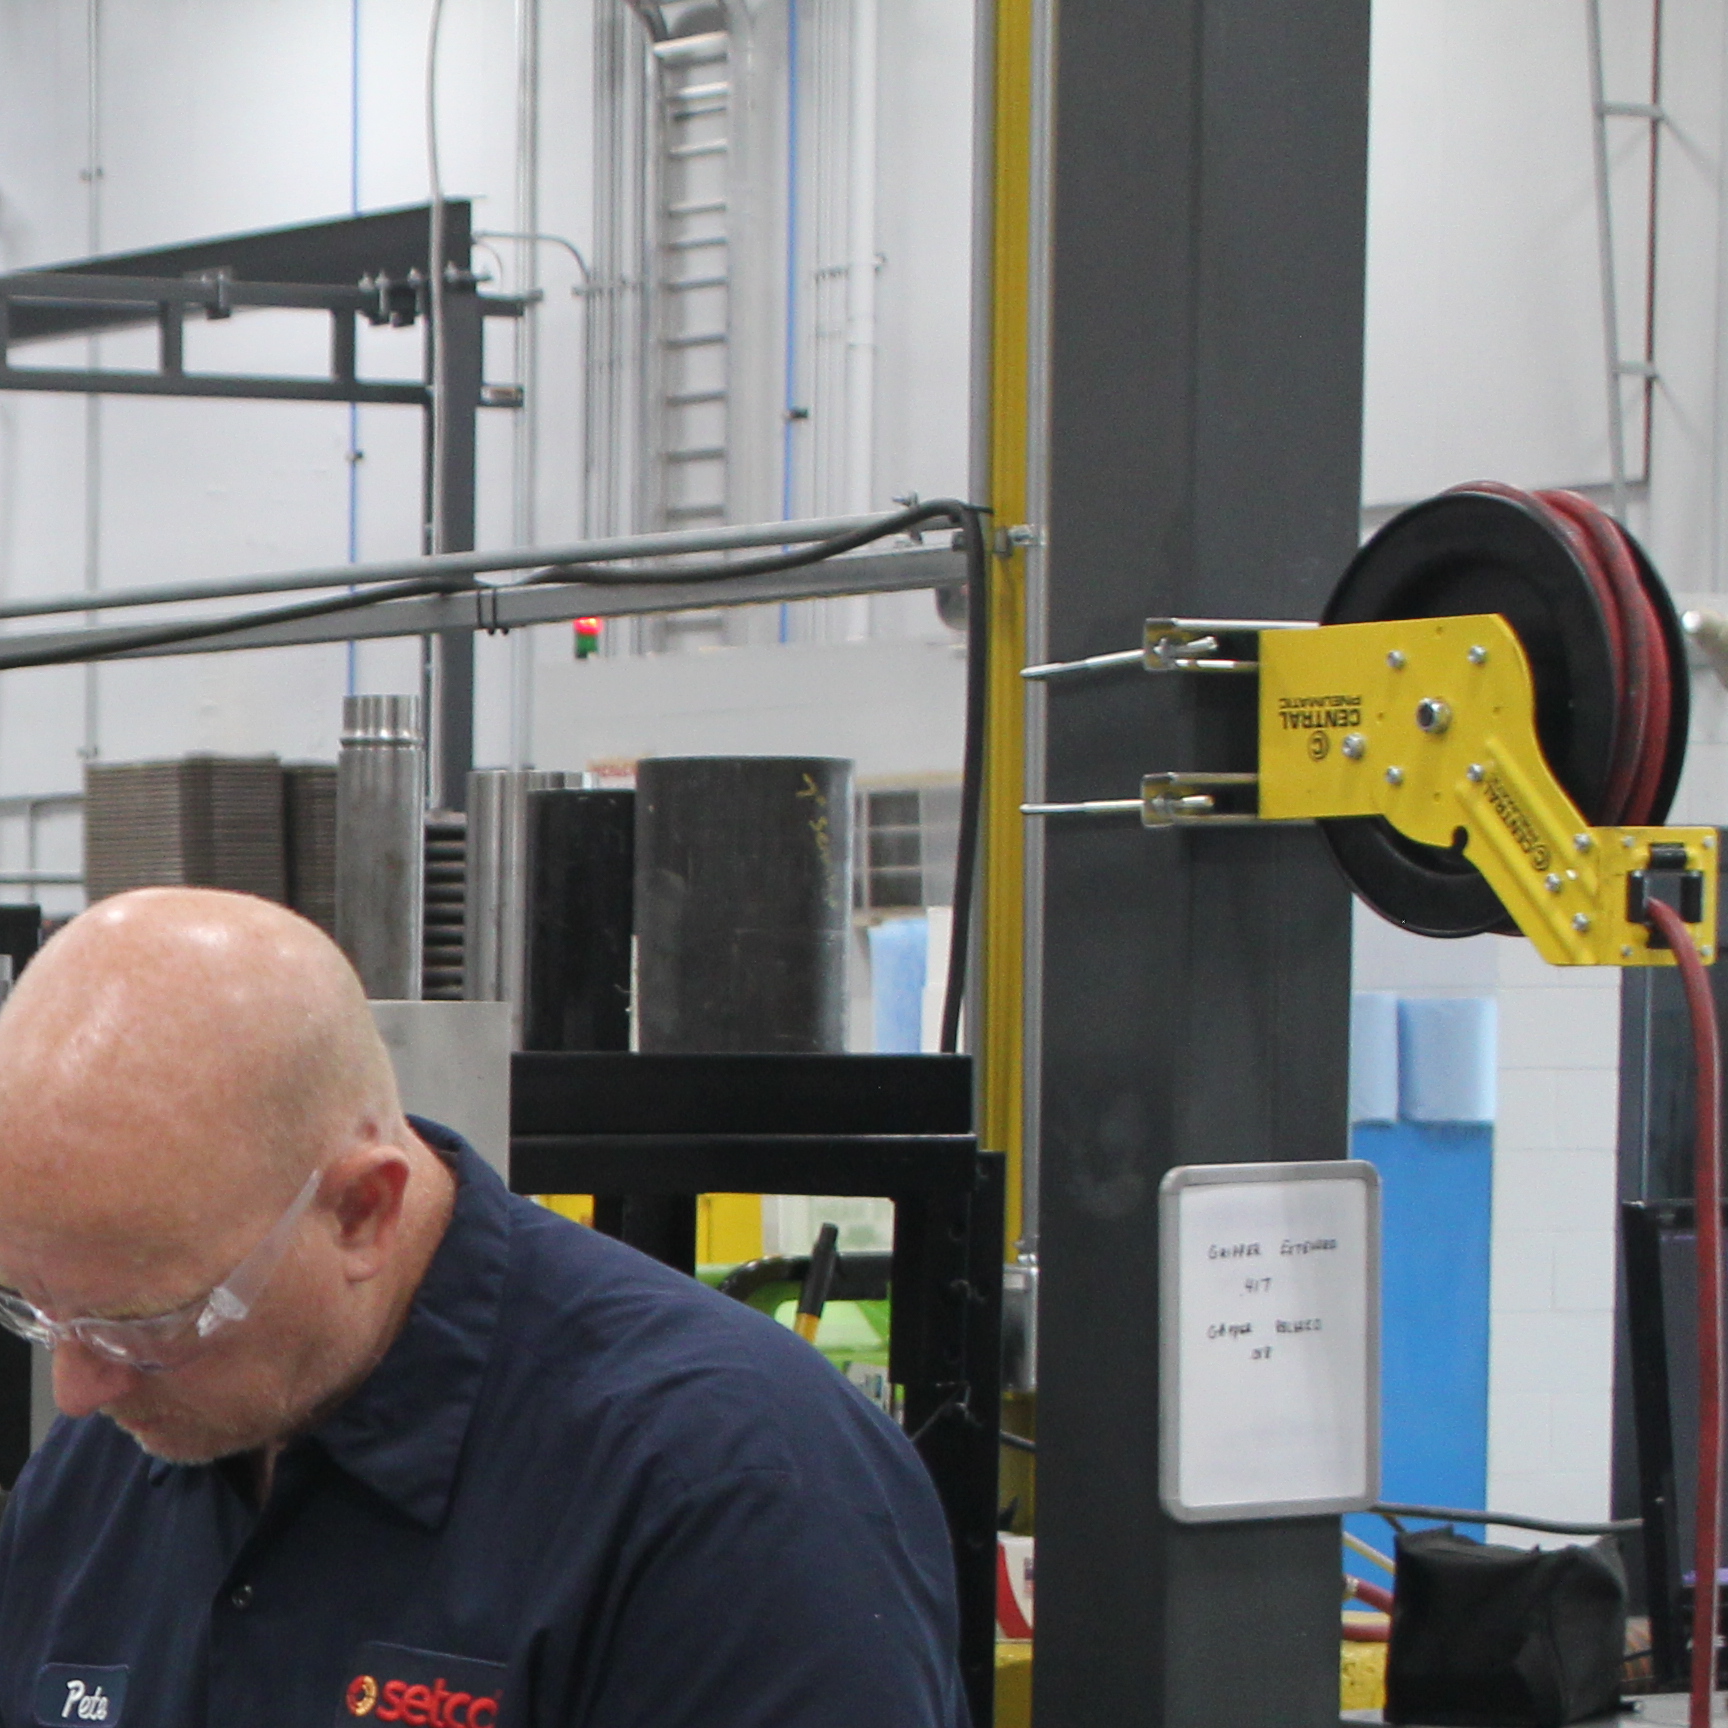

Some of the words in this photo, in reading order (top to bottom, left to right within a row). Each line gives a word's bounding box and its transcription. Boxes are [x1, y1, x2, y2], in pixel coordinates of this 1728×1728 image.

[1278, 695, 1360, 710] PNEUMATIC
[1278, 708, 1360, 730] CENTRAL
[61, 1678, 109, 1722] Pete
